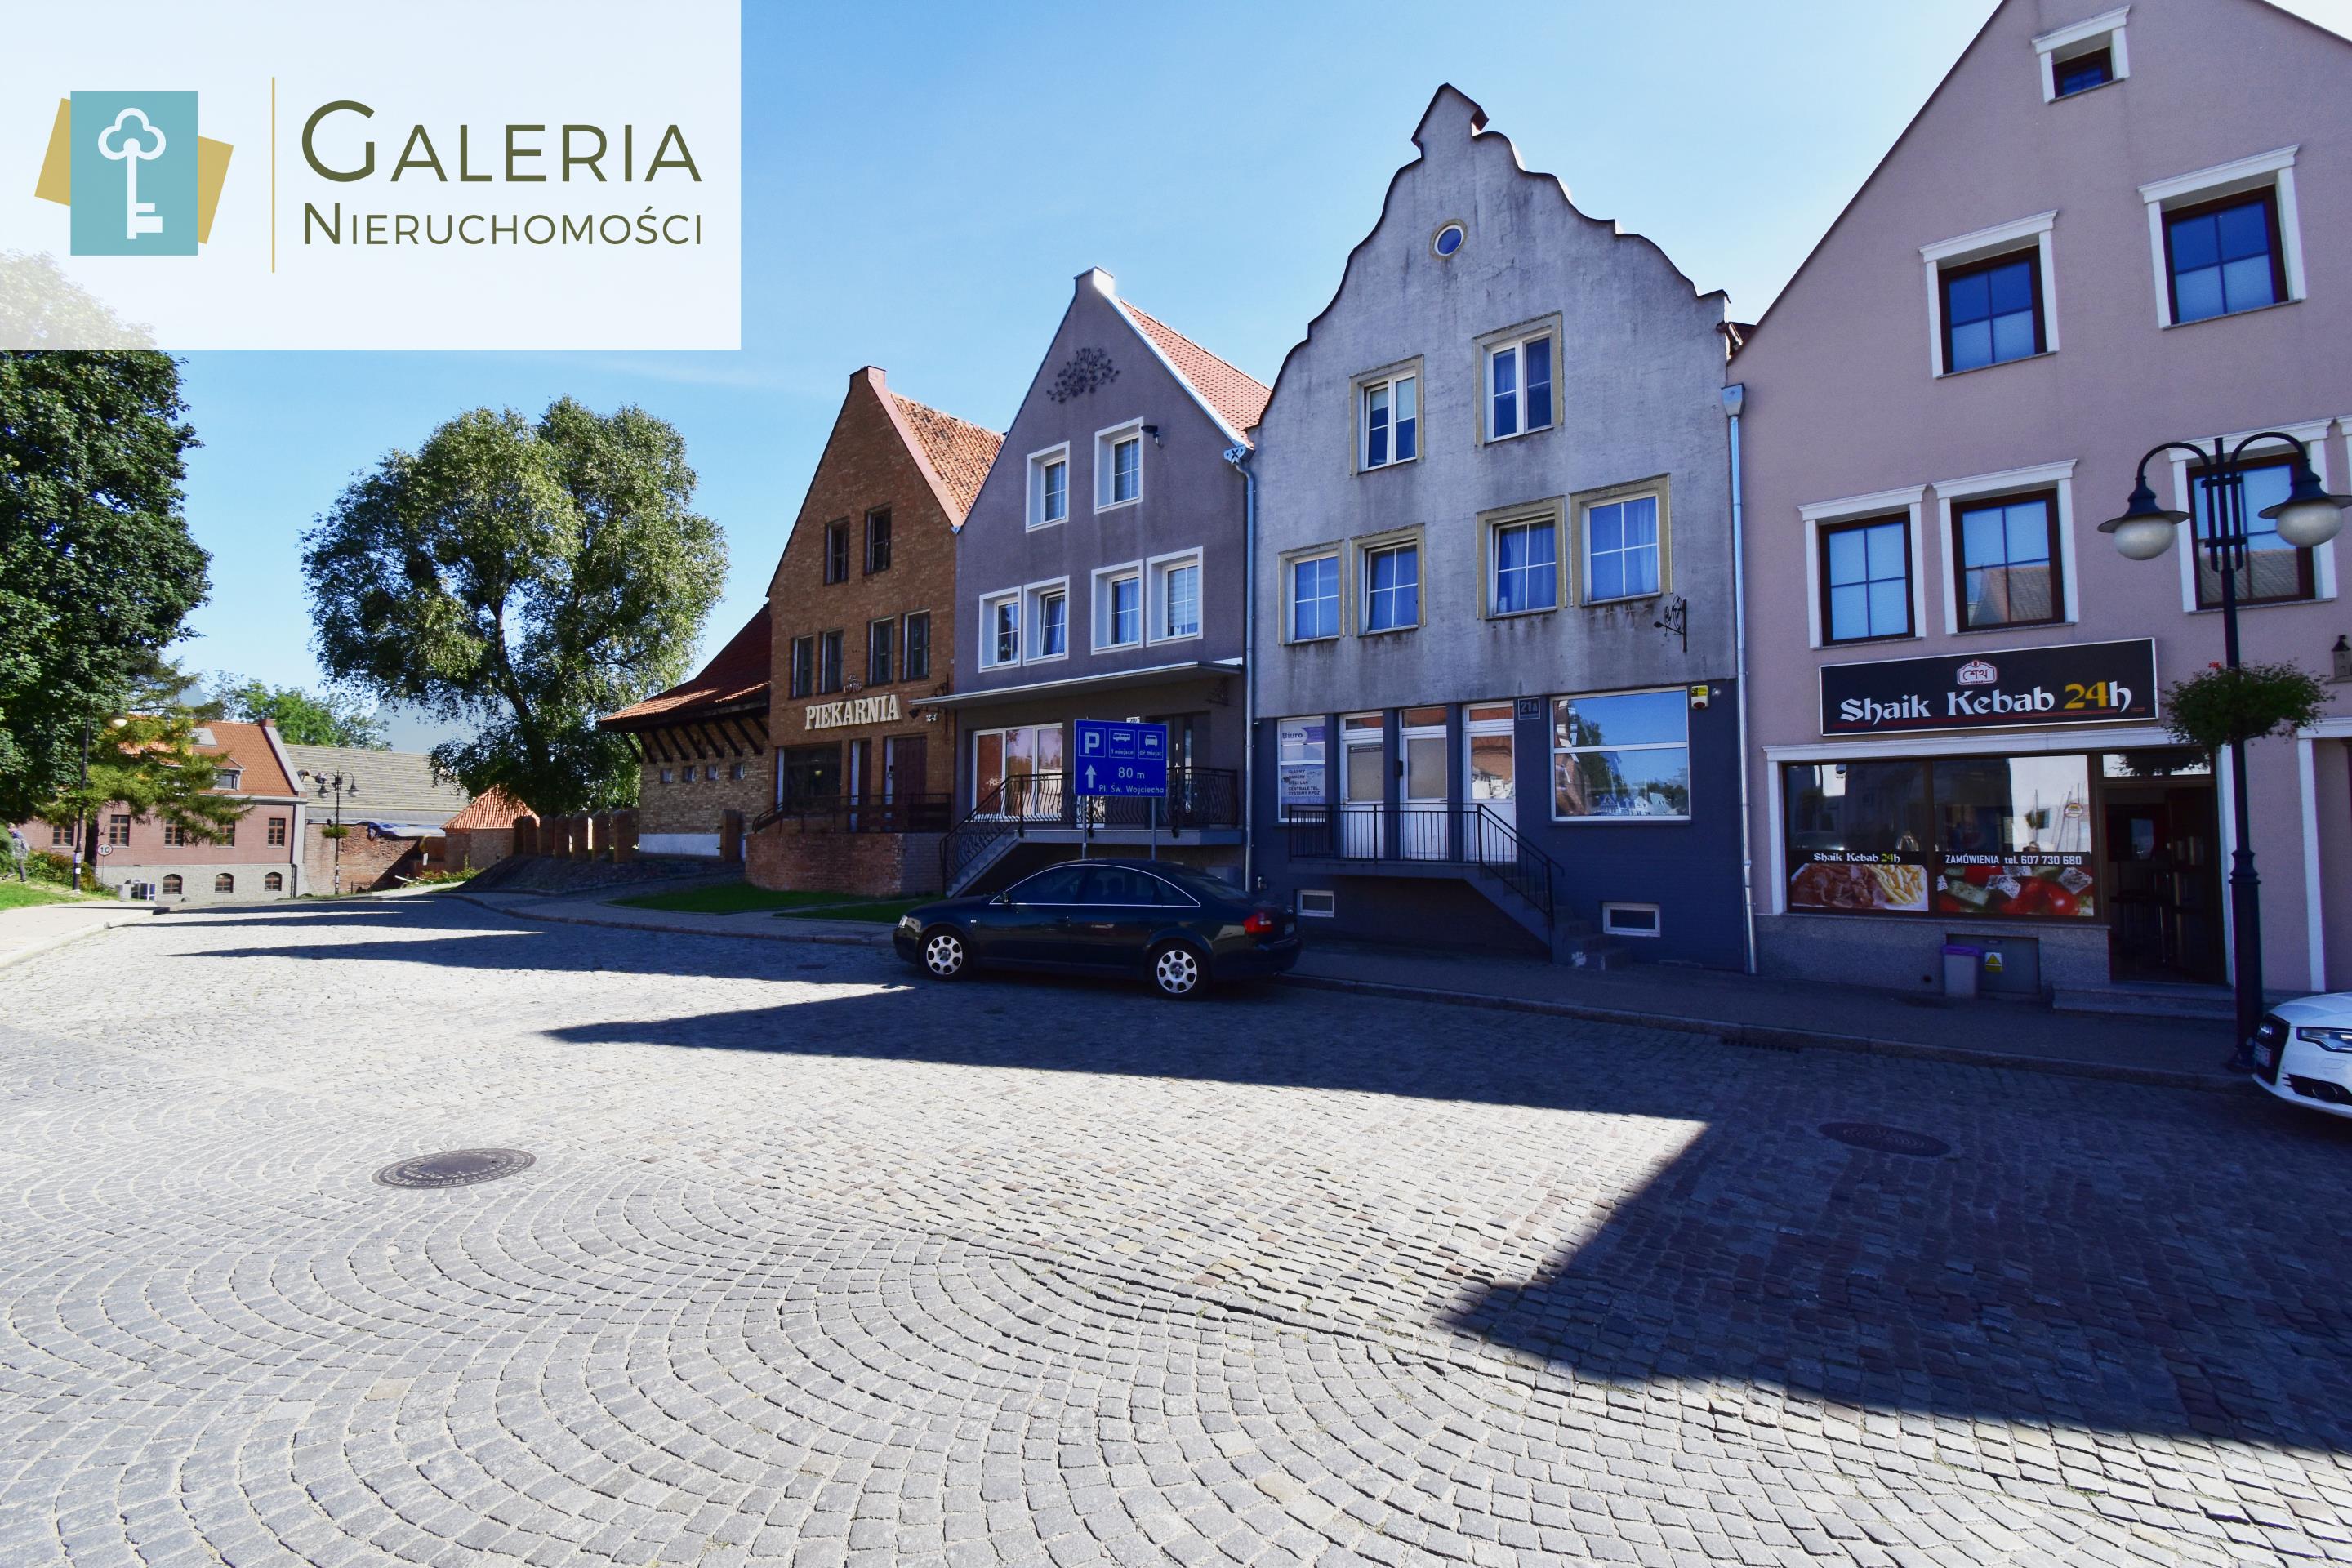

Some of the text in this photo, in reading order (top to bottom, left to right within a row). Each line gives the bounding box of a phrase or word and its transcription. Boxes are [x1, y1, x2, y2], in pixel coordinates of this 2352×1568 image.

[1840, 680, 2132, 725] Shaik Kebab 24h
[804, 694, 902, 730] PIEKARNIA
[1085, 732, 1100, 754] P
[1118, 766, 1134, 778] 80
[1098, 784, 1107, 792] Pl.
[1125, 785, 1165, 795] Wojciecha
[1814, 853, 1900, 863] Shaik Kebab 24h
[1945, 853, 2082, 865] ZAMÓWIENIA tel. 607 730 680
